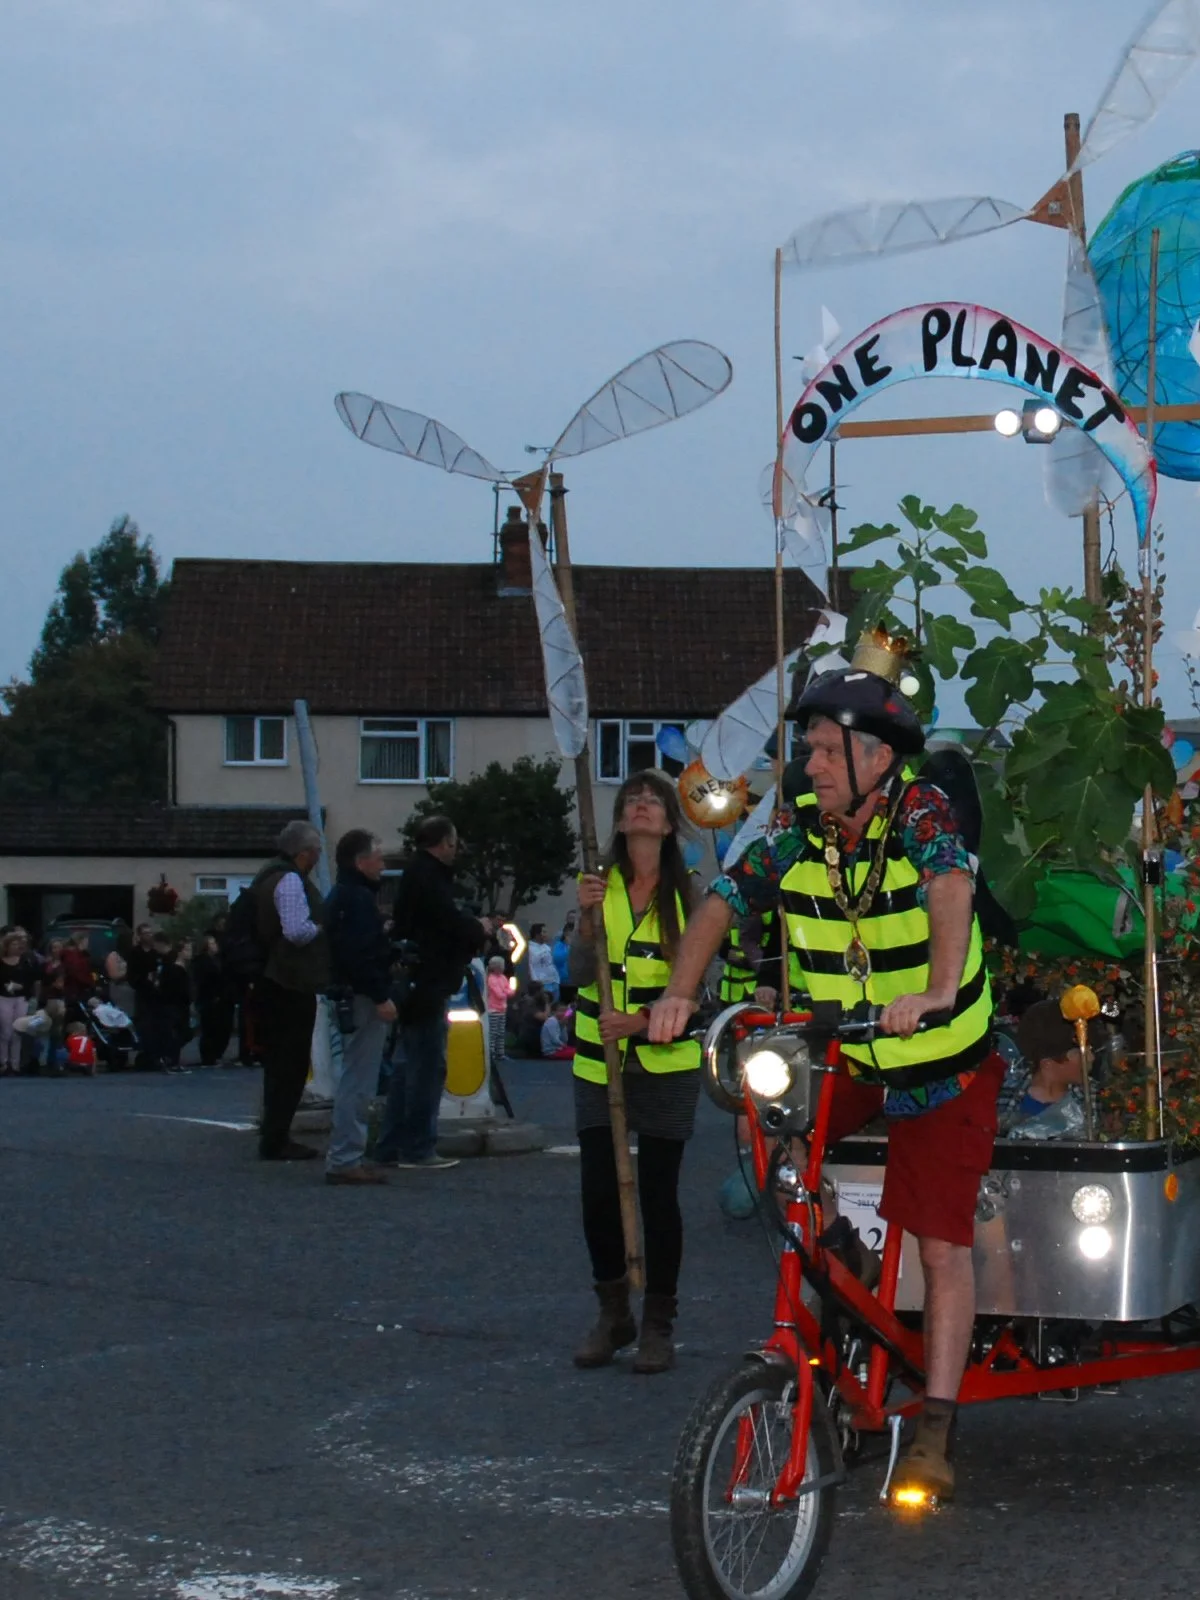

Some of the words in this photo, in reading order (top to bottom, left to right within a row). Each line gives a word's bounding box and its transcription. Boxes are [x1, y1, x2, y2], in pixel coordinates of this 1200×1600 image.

[792, 334, 892, 443] ONE
[922, 308, 1125, 431] PLANET
[73, 1036, 88, 1053] 7
